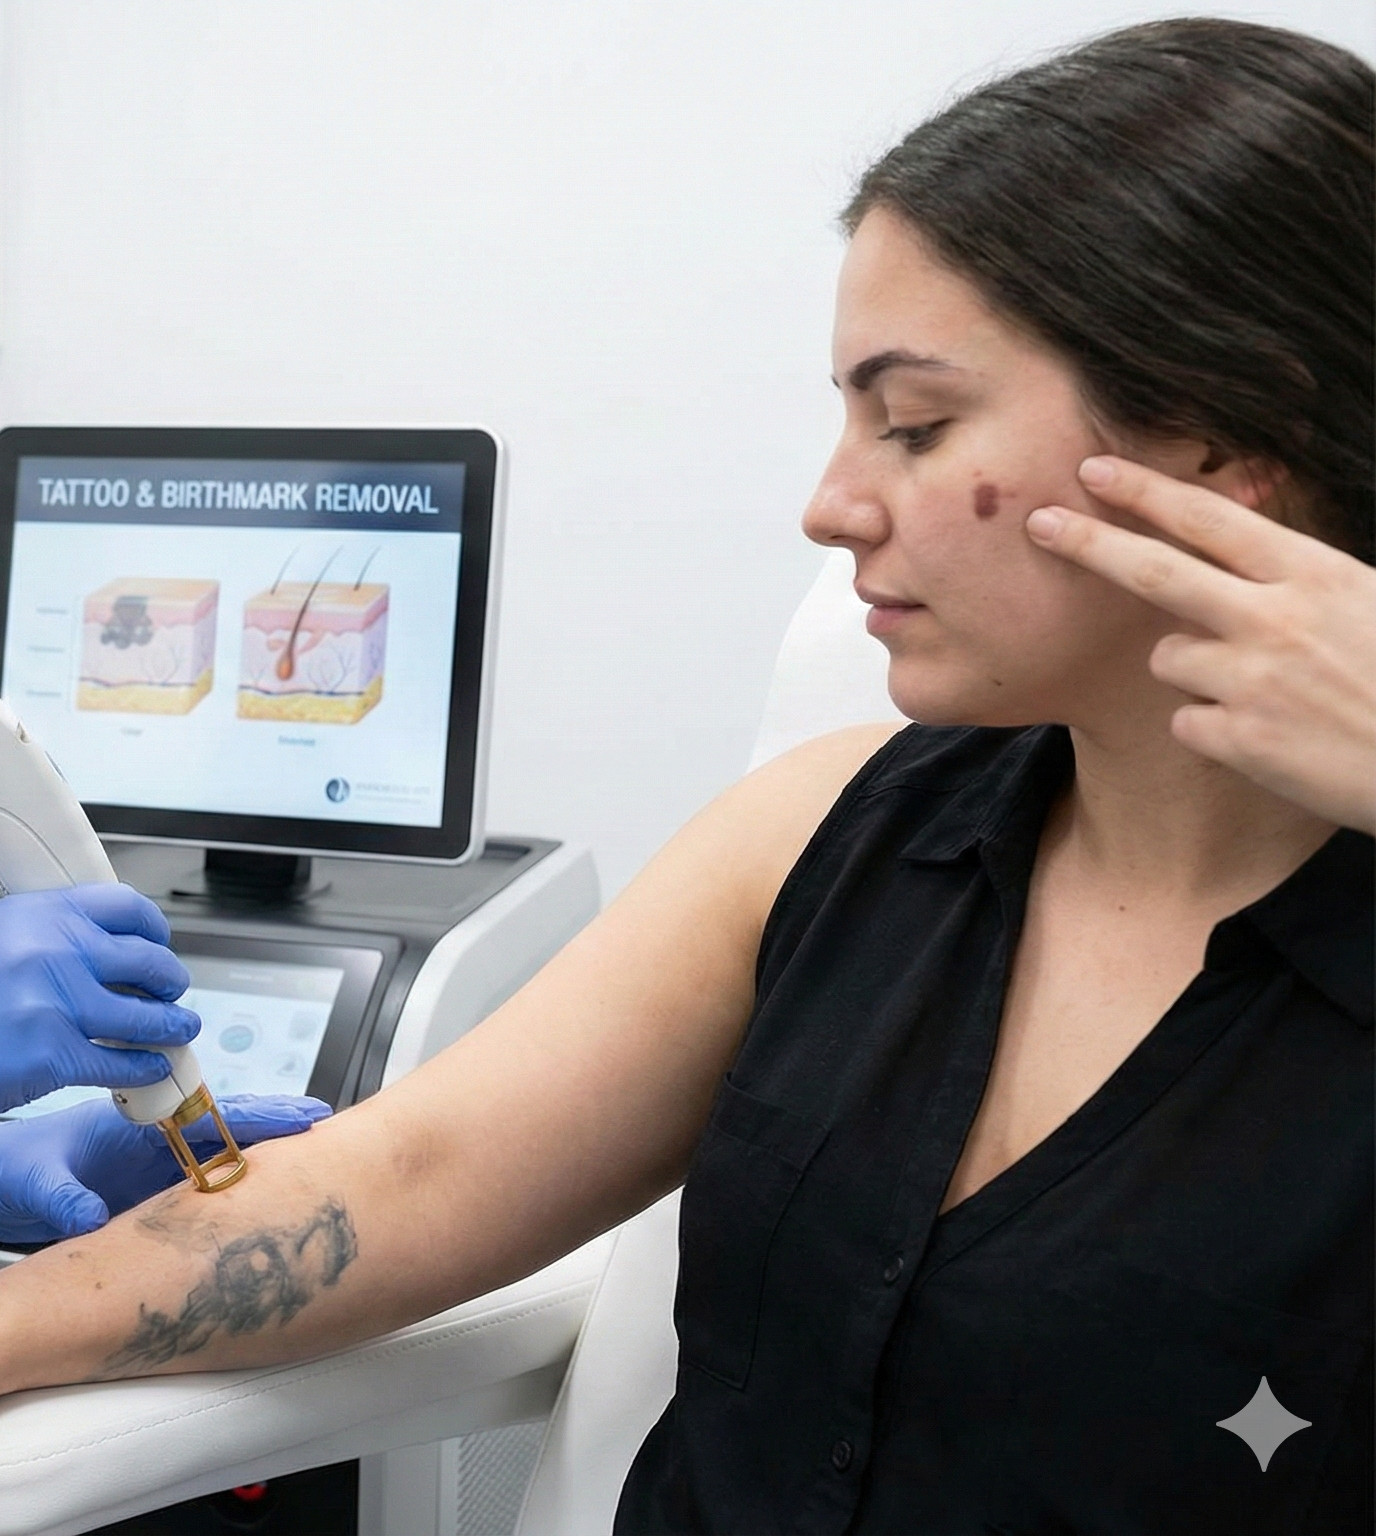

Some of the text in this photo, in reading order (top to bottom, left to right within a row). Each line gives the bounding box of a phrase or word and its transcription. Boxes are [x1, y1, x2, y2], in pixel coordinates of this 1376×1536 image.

[39, 479, 440, 514] TATTOO & BIRTHMARK REMOVAL
